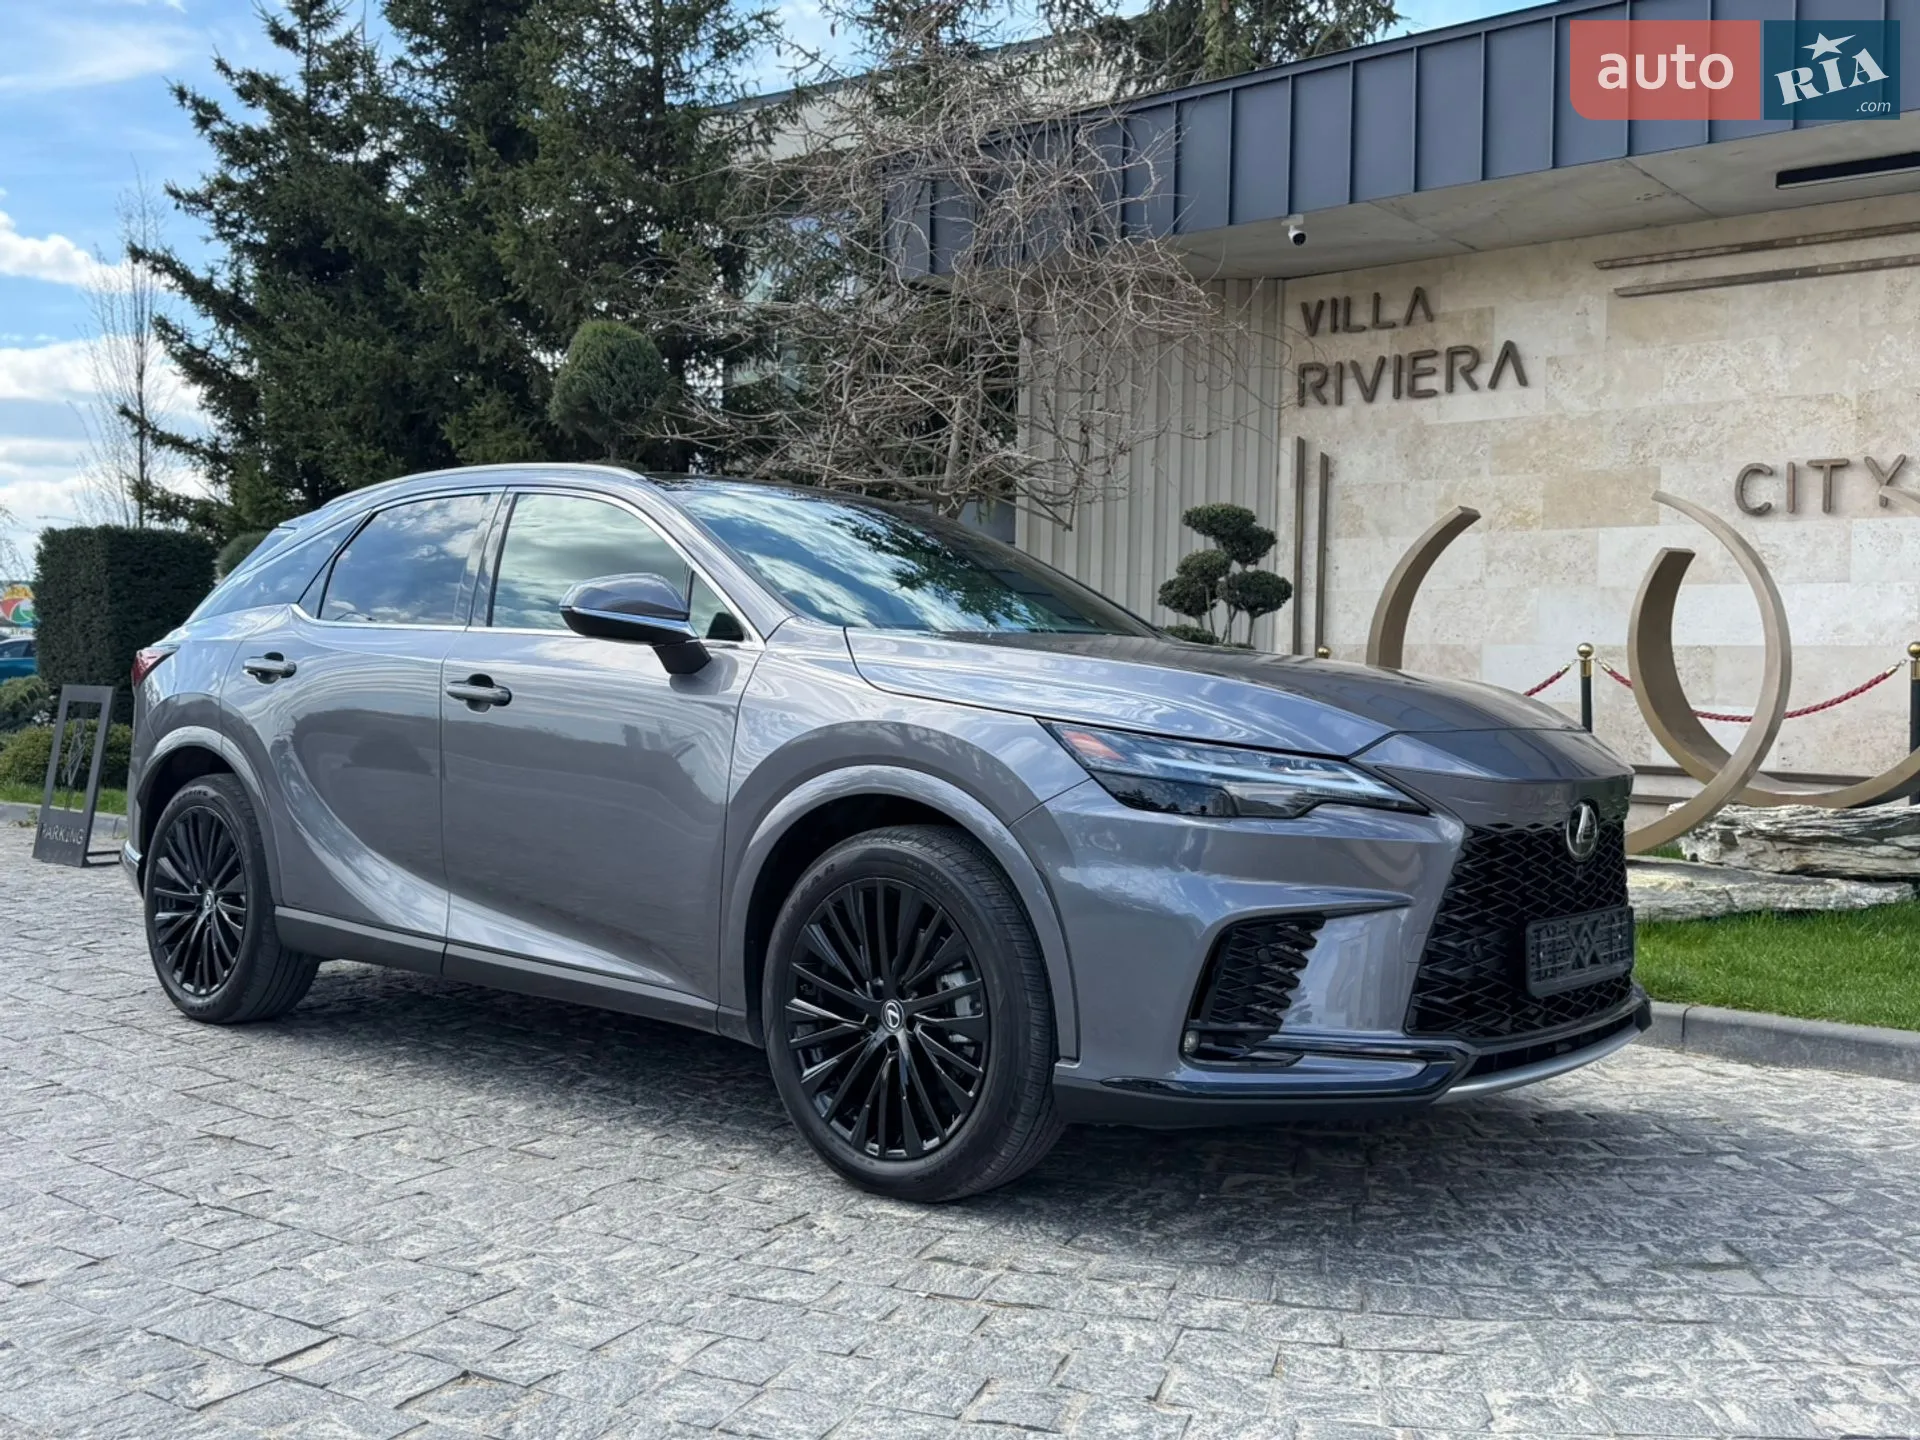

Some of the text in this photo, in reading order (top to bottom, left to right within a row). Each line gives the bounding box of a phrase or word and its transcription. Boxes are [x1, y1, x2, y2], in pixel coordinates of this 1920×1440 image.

[1301, 286, 1434, 337] VILLA
[1298, 340, 1529, 407] RIVIERA
[1735, 454, 1906, 516] CITY
[41, 822, 85, 845] PARKING
